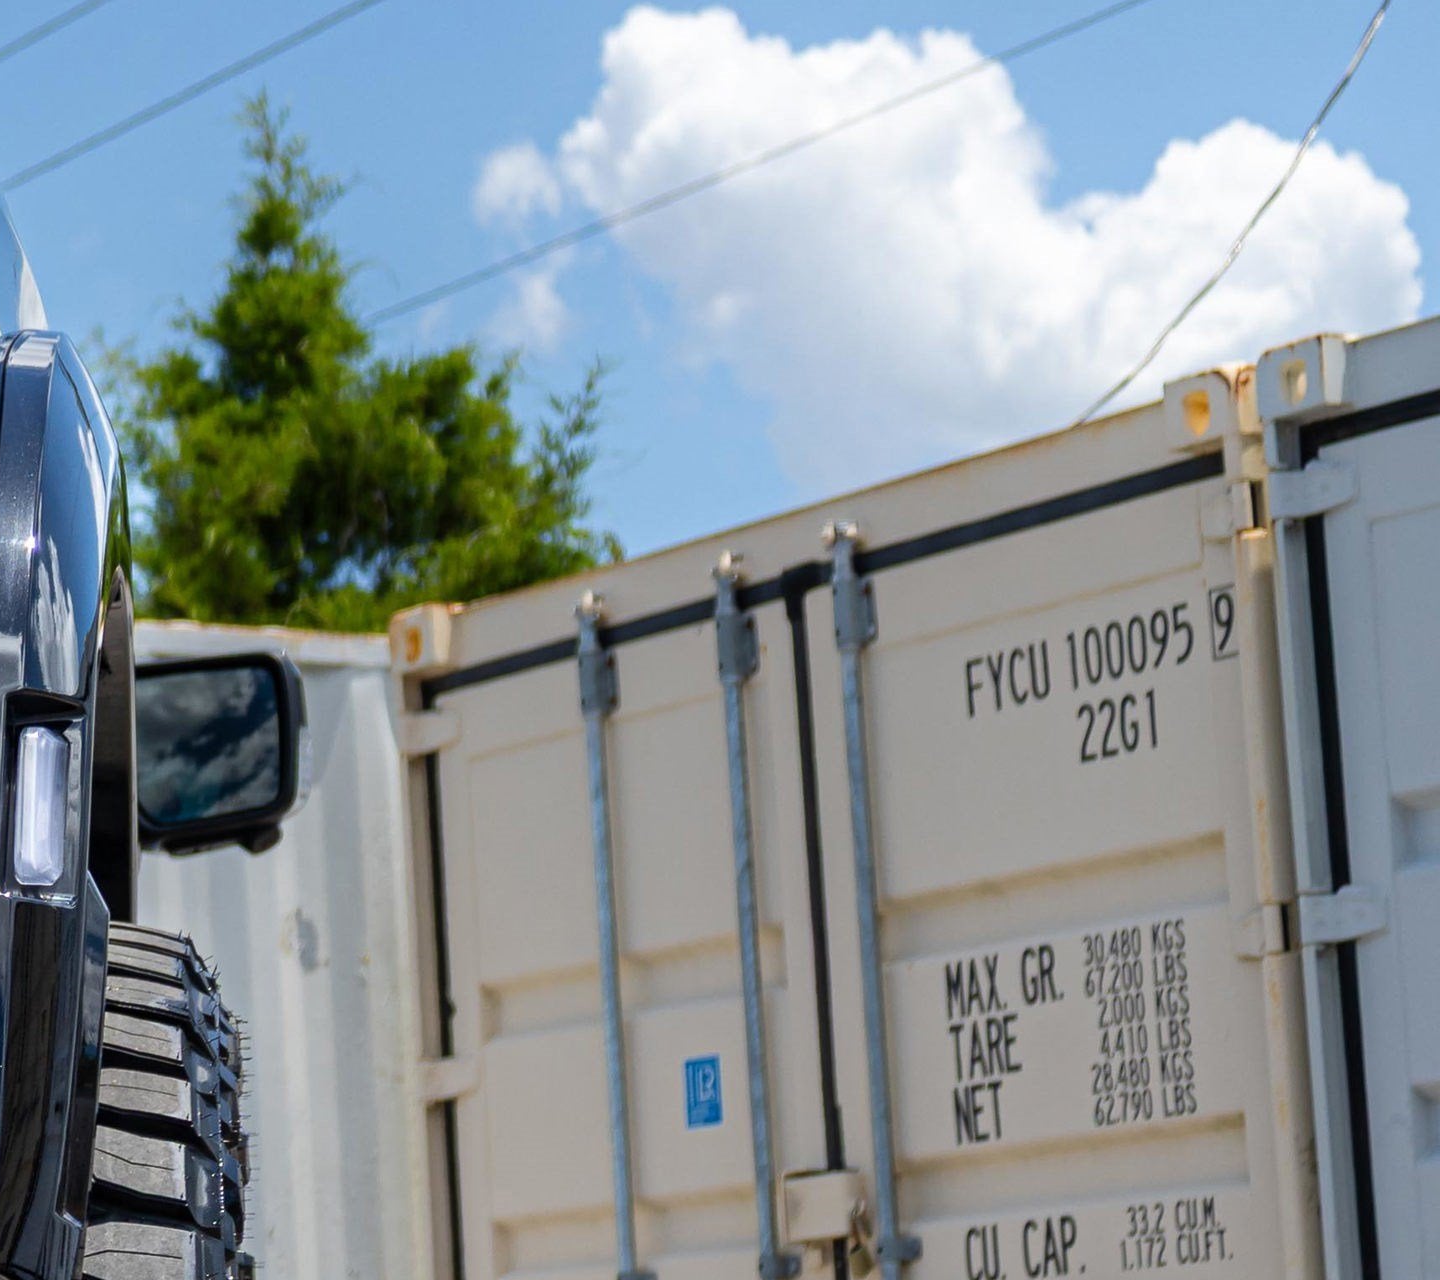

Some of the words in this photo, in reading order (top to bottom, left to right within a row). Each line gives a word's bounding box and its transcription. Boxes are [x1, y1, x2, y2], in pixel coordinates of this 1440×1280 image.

[965, 638, 1051, 719] FYCU
[1066, 602, 1195, 692] 100095
[1214, 592, 1235, 652] 9
[1078, 688, 1158, 763] 22G1
[945, 954, 1008, 1020] MAX.
[1021, 944, 1064, 1007] GR.
[1151, 919, 1186, 954] KGS
[1152, 952, 1188, 987] LBS
[949, 1013, 1023, 1083] TARE
[1155, 985, 1191, 1019] KGS
[1157, 1017, 1192, 1052] LBS
[953, 1080, 1003, 1147] NET
[1160, 1050, 1195, 1084] KGS
[1162, 1082, 1198, 1118] LBS
[1023, 1214, 1086, 1279] CAP.
